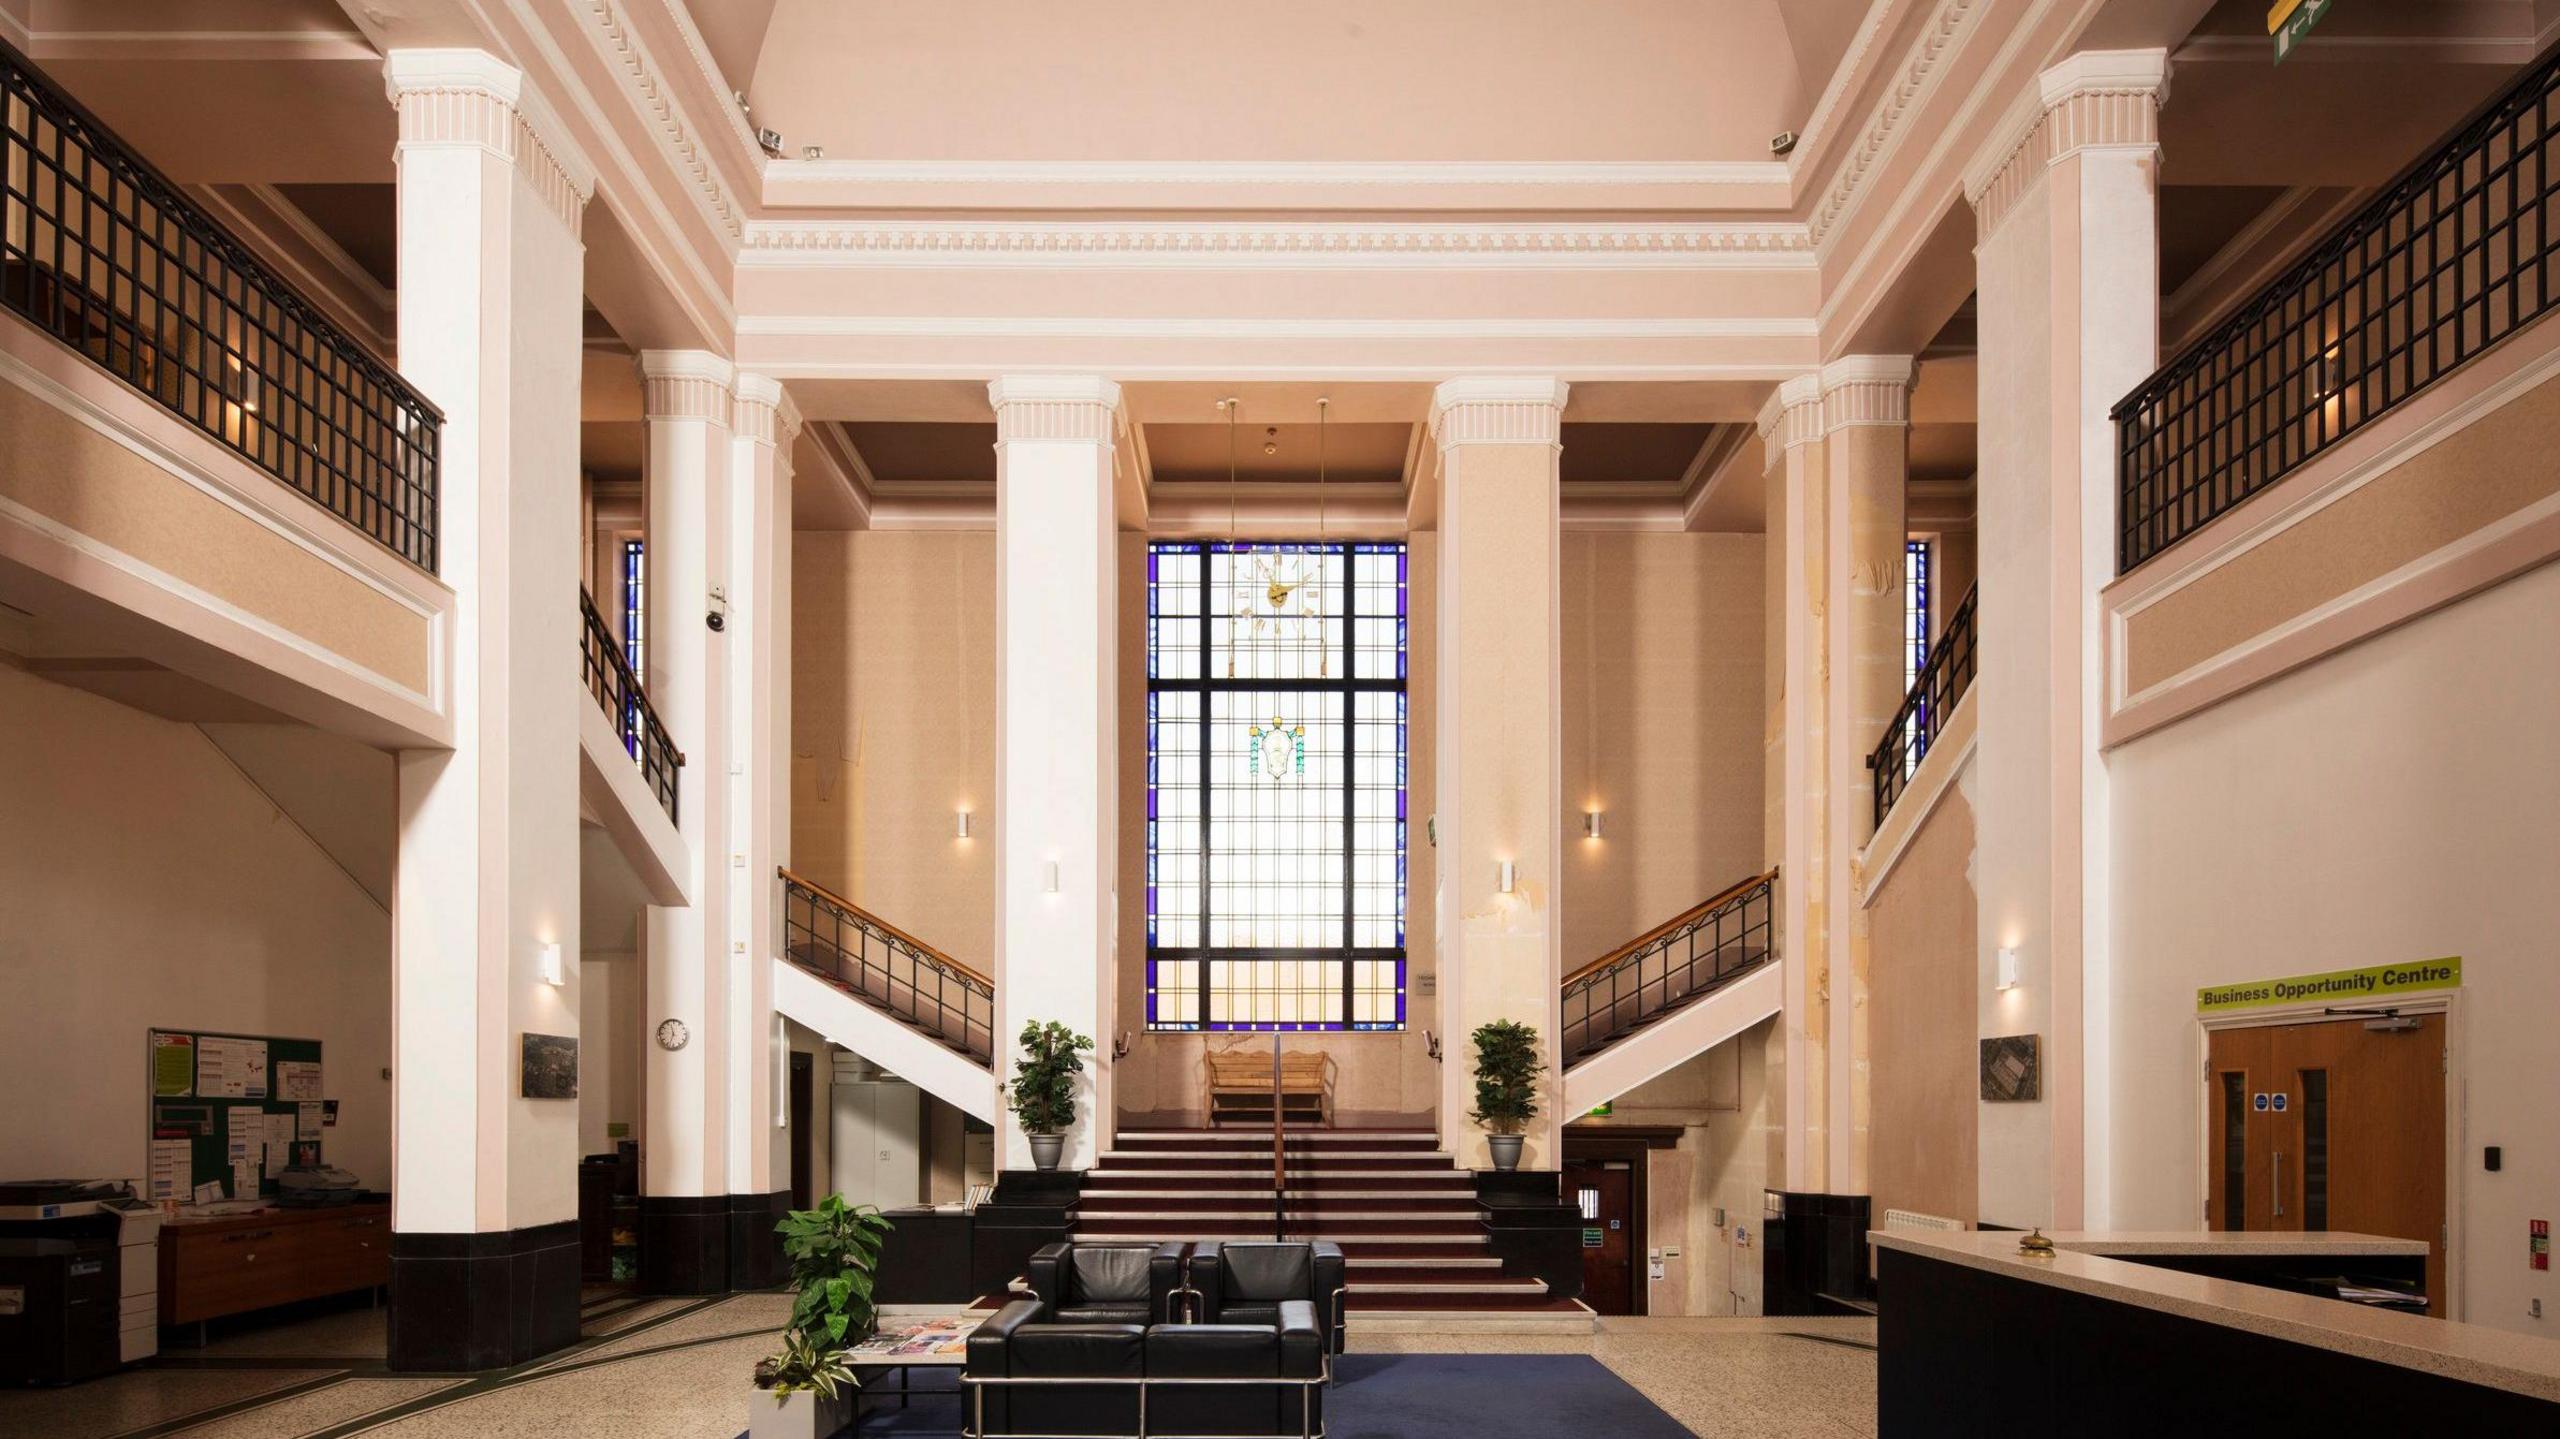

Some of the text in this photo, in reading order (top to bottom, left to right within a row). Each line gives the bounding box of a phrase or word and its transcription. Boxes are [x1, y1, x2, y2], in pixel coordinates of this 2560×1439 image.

[2203, 965, 2452, 1006] Business Opportunity Centre
